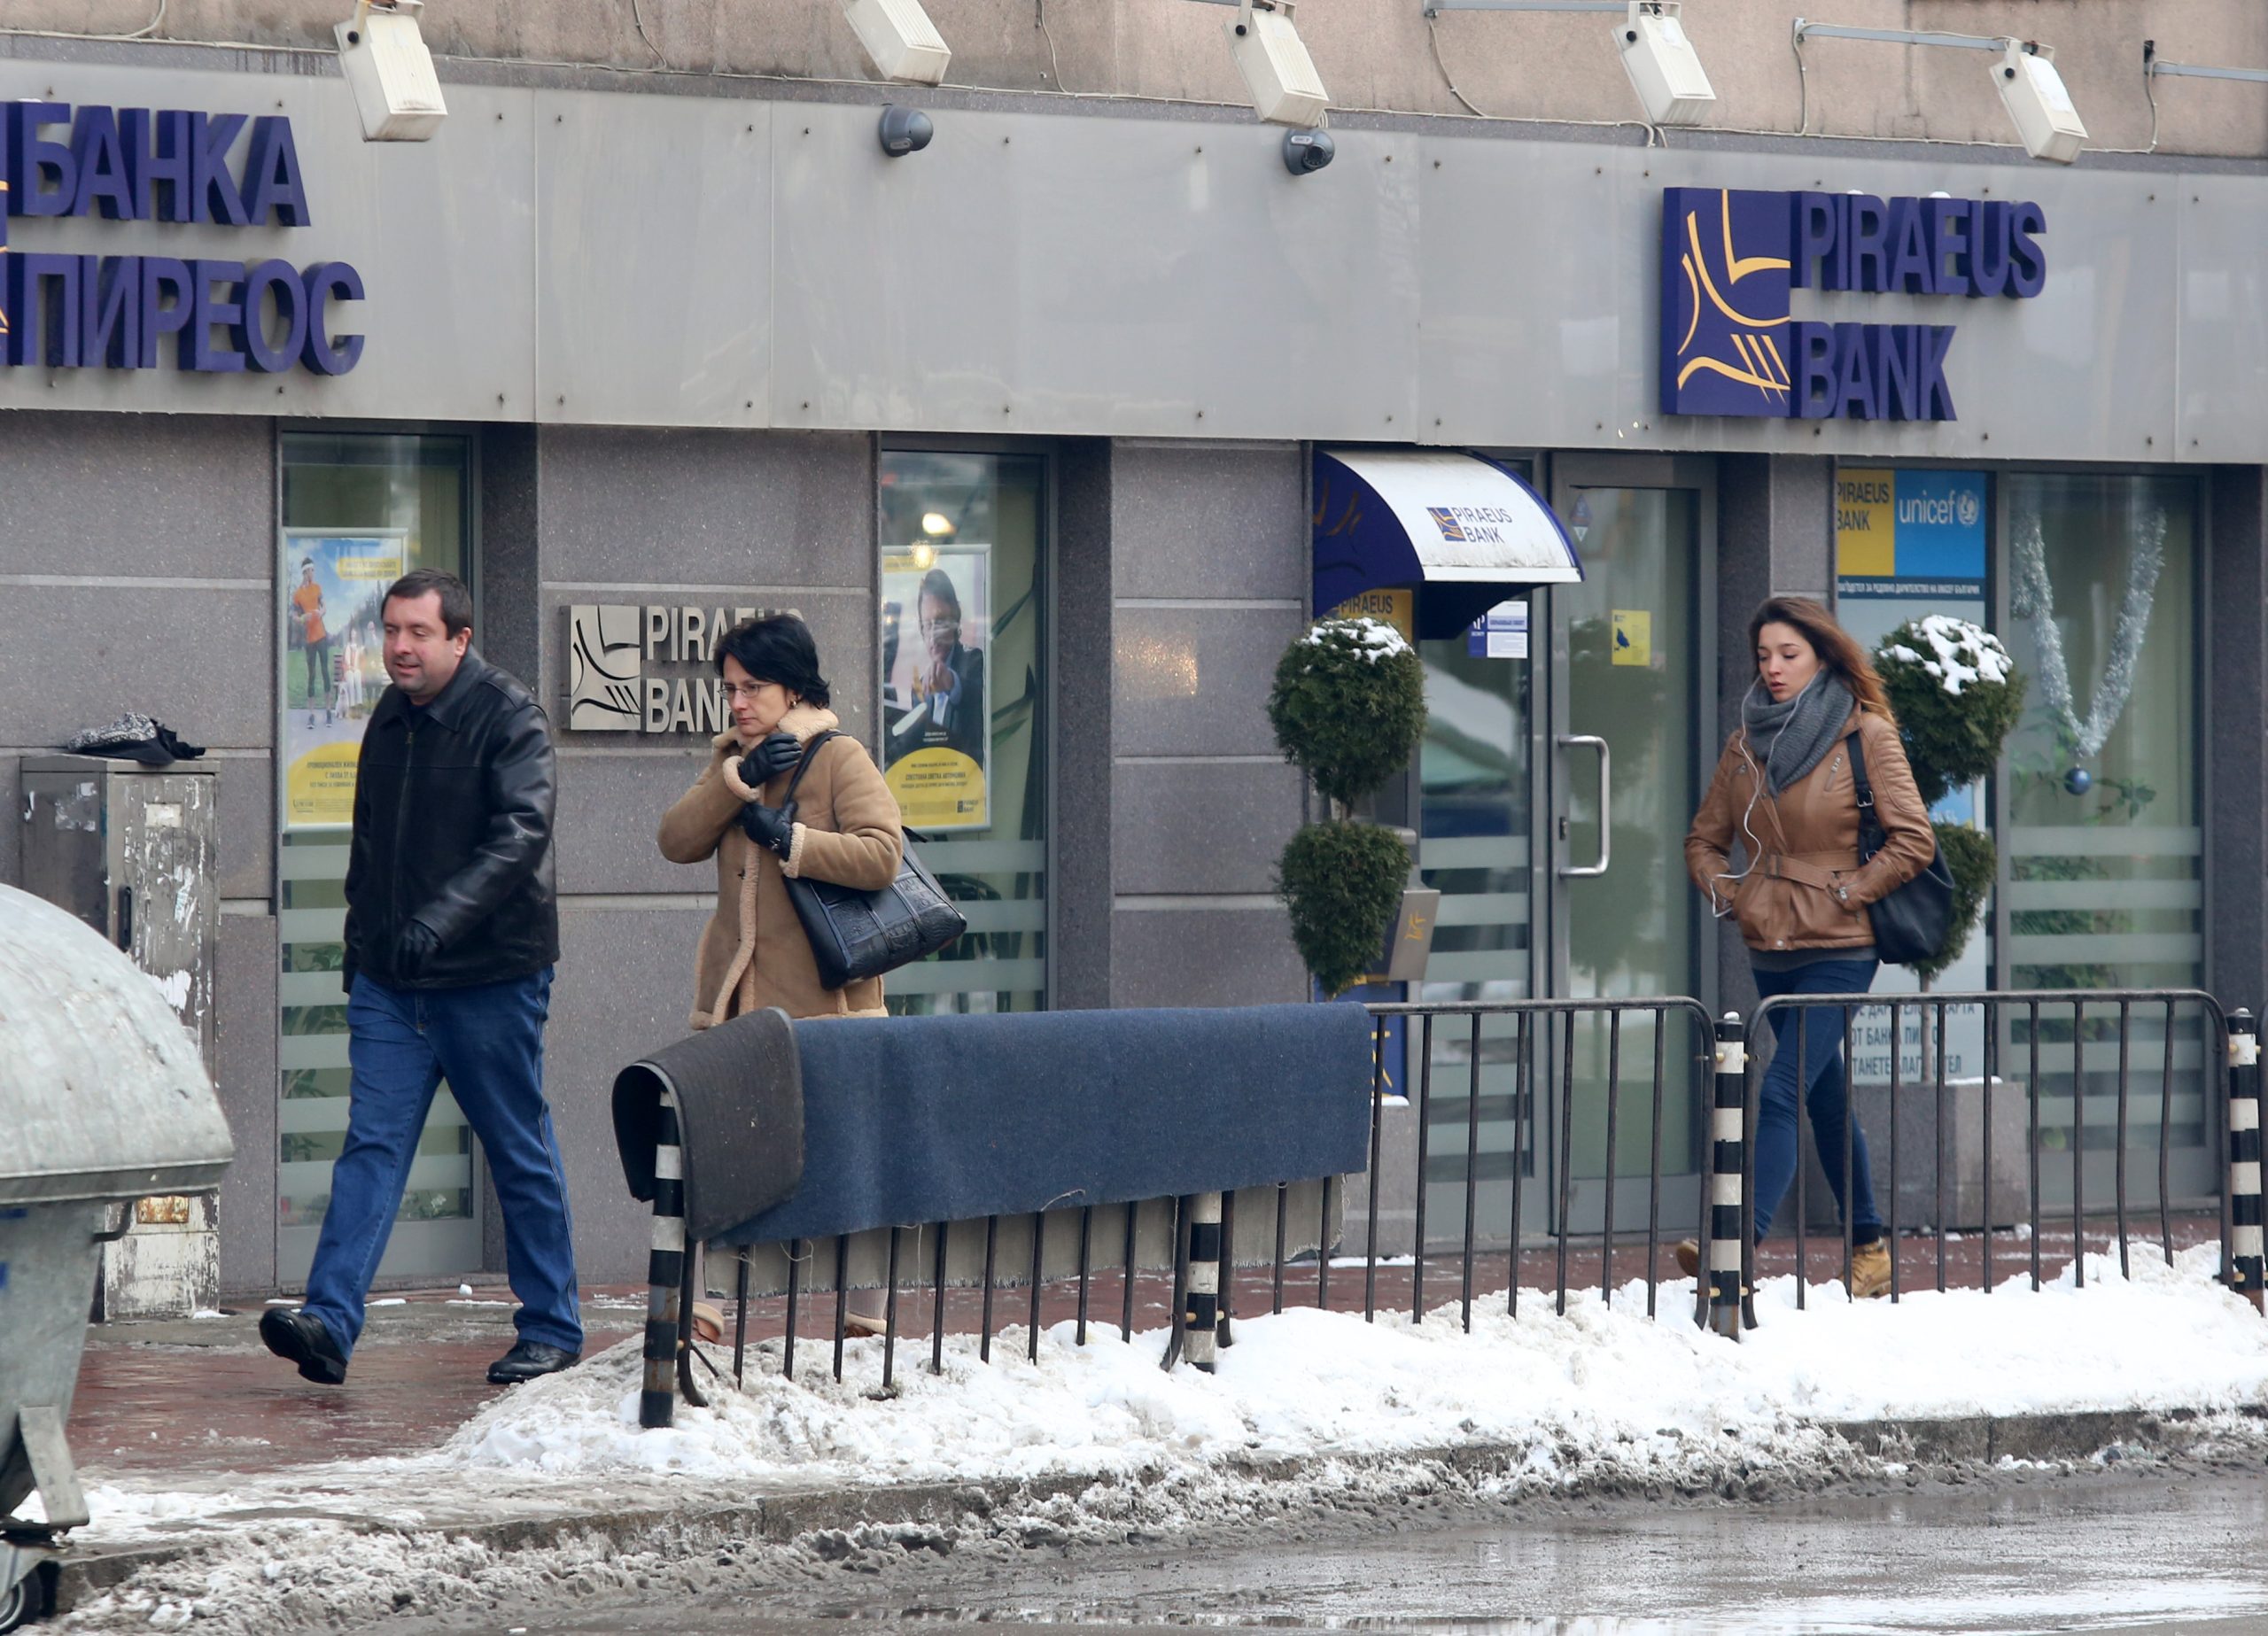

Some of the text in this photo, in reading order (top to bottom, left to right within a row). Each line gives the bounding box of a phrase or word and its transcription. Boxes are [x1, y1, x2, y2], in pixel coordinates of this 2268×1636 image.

[9, 100, 310, 227] БАНКА
[1791, 191, 2047, 299] PIRAEUS
[11, 252, 365, 376] ПИРЕОС
[1791, 322, 1957, 421] BANK
[1451, 507, 1512, 523] PIRAEUS
[1837, 509, 1871, 531] BANK
[1899, 490, 1956, 524] unicef
[1463, 526, 1505, 544] BANK
[646, 606, 804, 661] PIRA
[1850, 1056, 1891, 1074] ТАНЕТЕ
